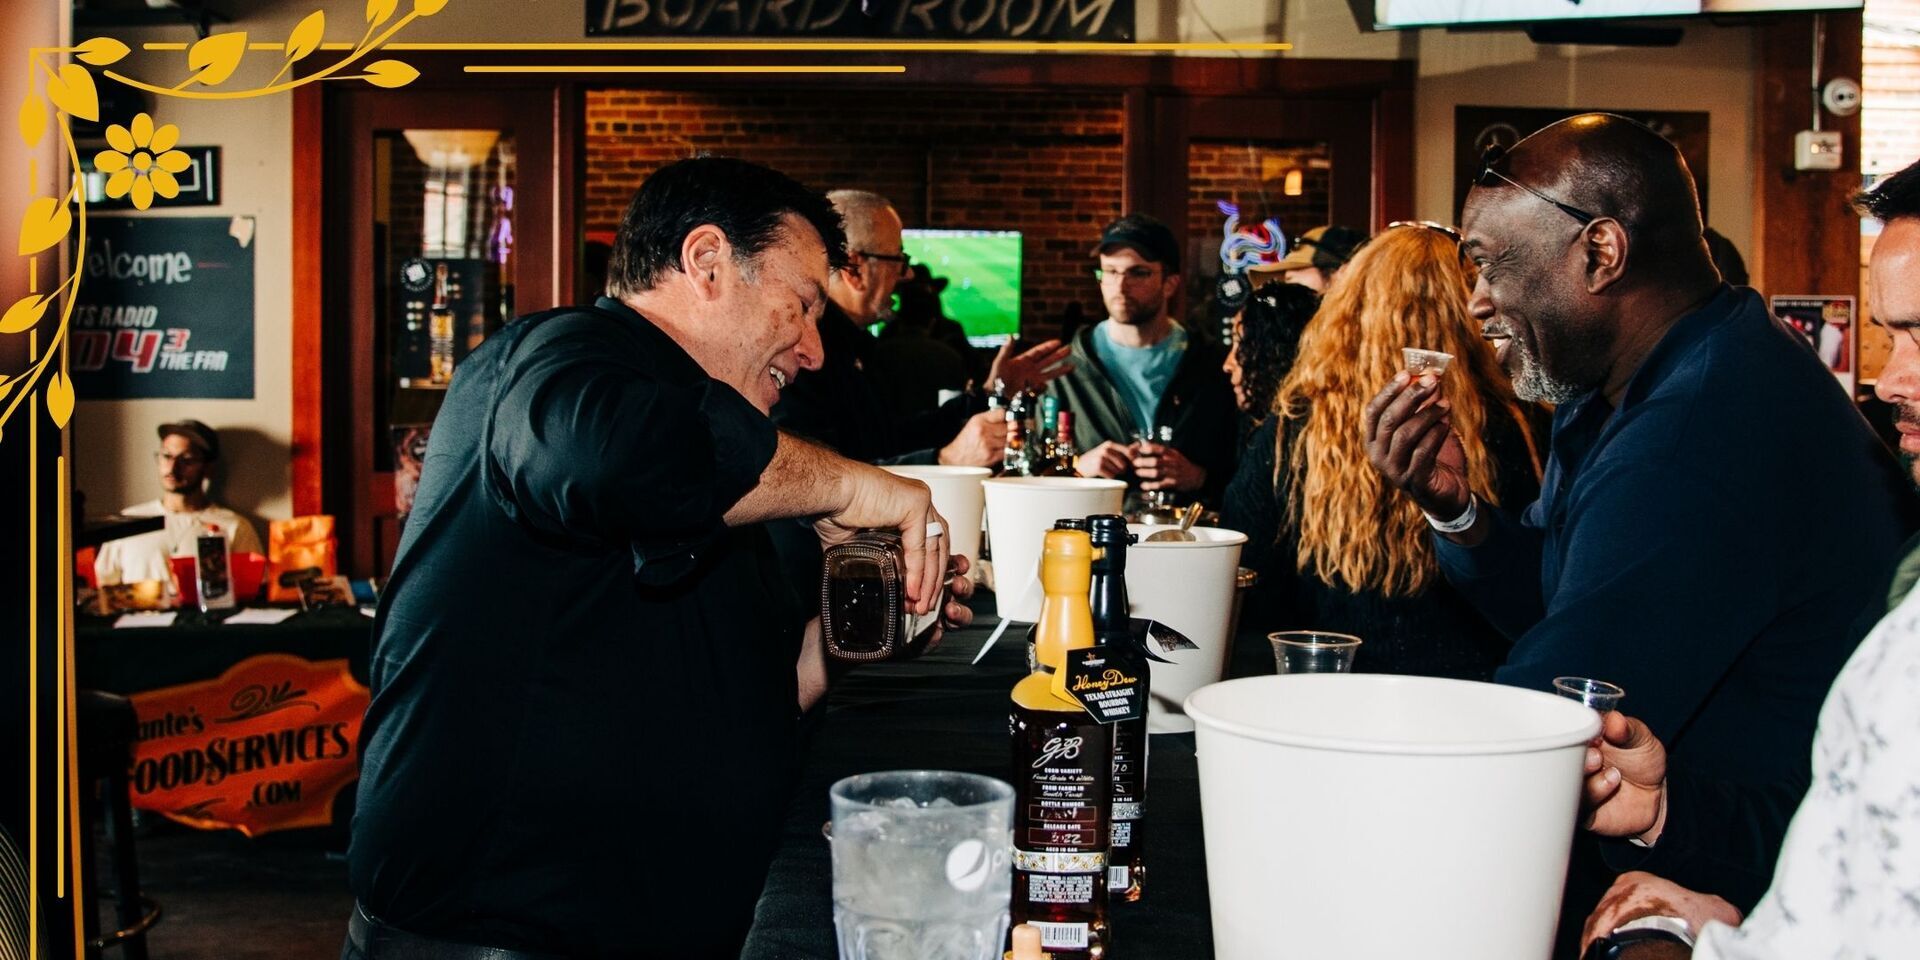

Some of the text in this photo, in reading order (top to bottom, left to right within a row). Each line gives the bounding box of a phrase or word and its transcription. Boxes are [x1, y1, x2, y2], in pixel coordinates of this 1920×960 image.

[100, 305, 158, 328] RADIO
[159, 351, 194, 371] THE
[1072, 669, 1137, 691] Honey Dew
[1084, 687, 1135, 702] TEXAS STRAIGHT
[1098, 697, 1129, 709] BOURBON
[1102, 706, 1130, 717] WHISKEY
[128, 722, 350, 795] OODSERVICES
